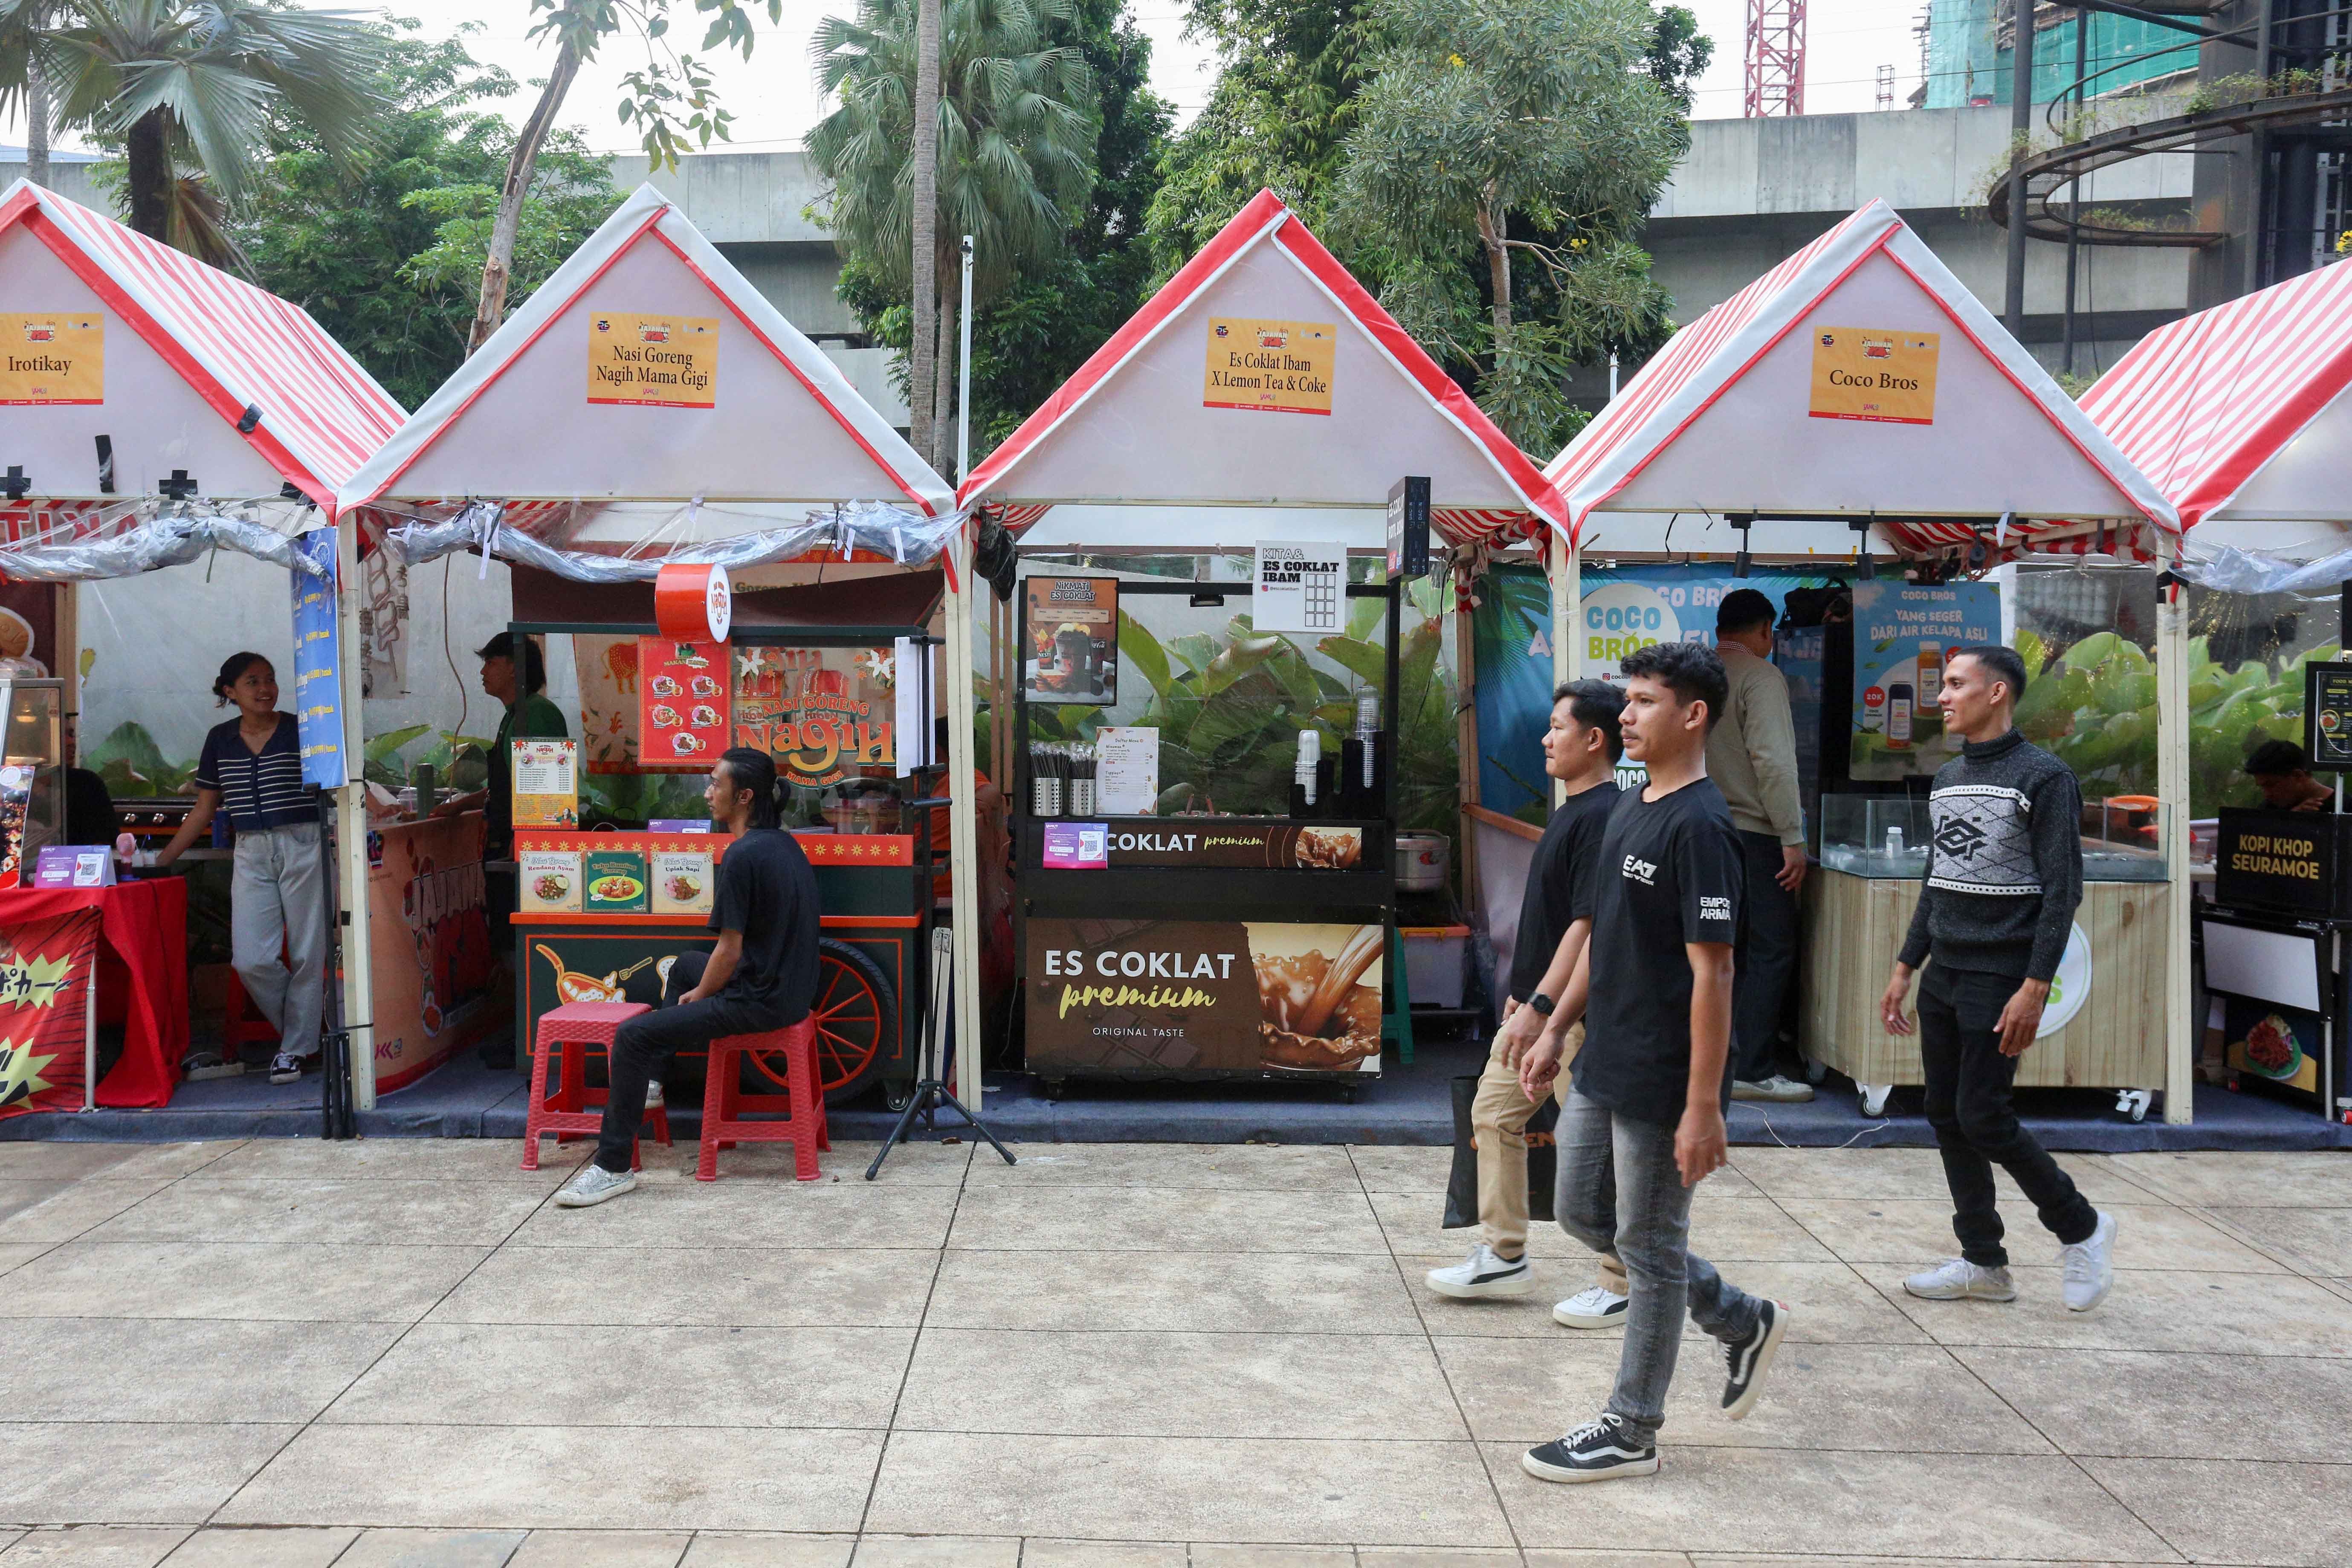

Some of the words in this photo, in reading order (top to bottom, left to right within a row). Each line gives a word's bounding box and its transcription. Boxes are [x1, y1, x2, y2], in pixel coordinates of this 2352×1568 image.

[8, 355, 72, 376] Irotikay
[614, 345, 640, 361] Nasi
[645, 347, 692, 369] Goreng
[1230, 352, 1241, 367] Es
[1245, 353, 1280, 369] Coklat
[1283, 355, 1310, 371] Ibam
[597, 365, 633, 386] Nagih
[637, 367, 677, 384] Mama
[682, 370, 707, 390] Gigi
[1211, 371, 1220, 385] X
[1223, 371, 1260, 388] Lemon
[1264, 374, 1283, 390] Tea
[1287, 375, 1296, 391] &
[1299, 377, 1326, 393] Coke
[1830, 370, 1873, 387] Coco
[1878, 373, 1918, 390] Bros
[1388, 501, 1393, 518] ES
[1263, 548, 1304, 559] KITA&
[1262, 561, 1280, 572] ES
[1284, 561, 1339, 573] COKLAT
[1262, 572, 1301, 583] IBAM
[1050, 591, 1061, 600] ES
[1063, 591, 1095, 601] COKLAT
[1901, 591, 1929, 600] COCO
[1931, 591, 1956, 601] BROS
[1587, 606, 1661, 631] COCO
[1895, 609, 1926, 622] YANG
[1929, 609, 1963, 622] SEGER
[1871, 625, 1897, 640] DARI
[1900, 625, 1918, 637] AIR
[1921, 625, 1962, 639] KELAPA
[1964, 627, 1988, 641] ASLI
[761, 697, 799, 716] NASI
[804, 696, 870, 716] GORENG
[786, 771, 817, 786] MAMA
[820, 770, 844, 785] GIGI
[1613, 769, 1647, 791] OCO
[1107, 833, 1197, 851] COKLAT
[1204, 836, 1265, 850] premium
[2239, 835, 2270, 853] KOPI
[2273, 836, 2313, 858] KHOP
[1623, 854, 1657, 879] EA7
[2231, 854, 2320, 881] SEURAMOE
[1045, 950, 1083, 976] ES
[1096, 952, 1236, 979] COKLAT
[1059, 983, 1216, 1020] premium
[1092, 1027, 1148, 1037] ORIGINAL
[1152, 1028, 1185, 1038] TASTE
